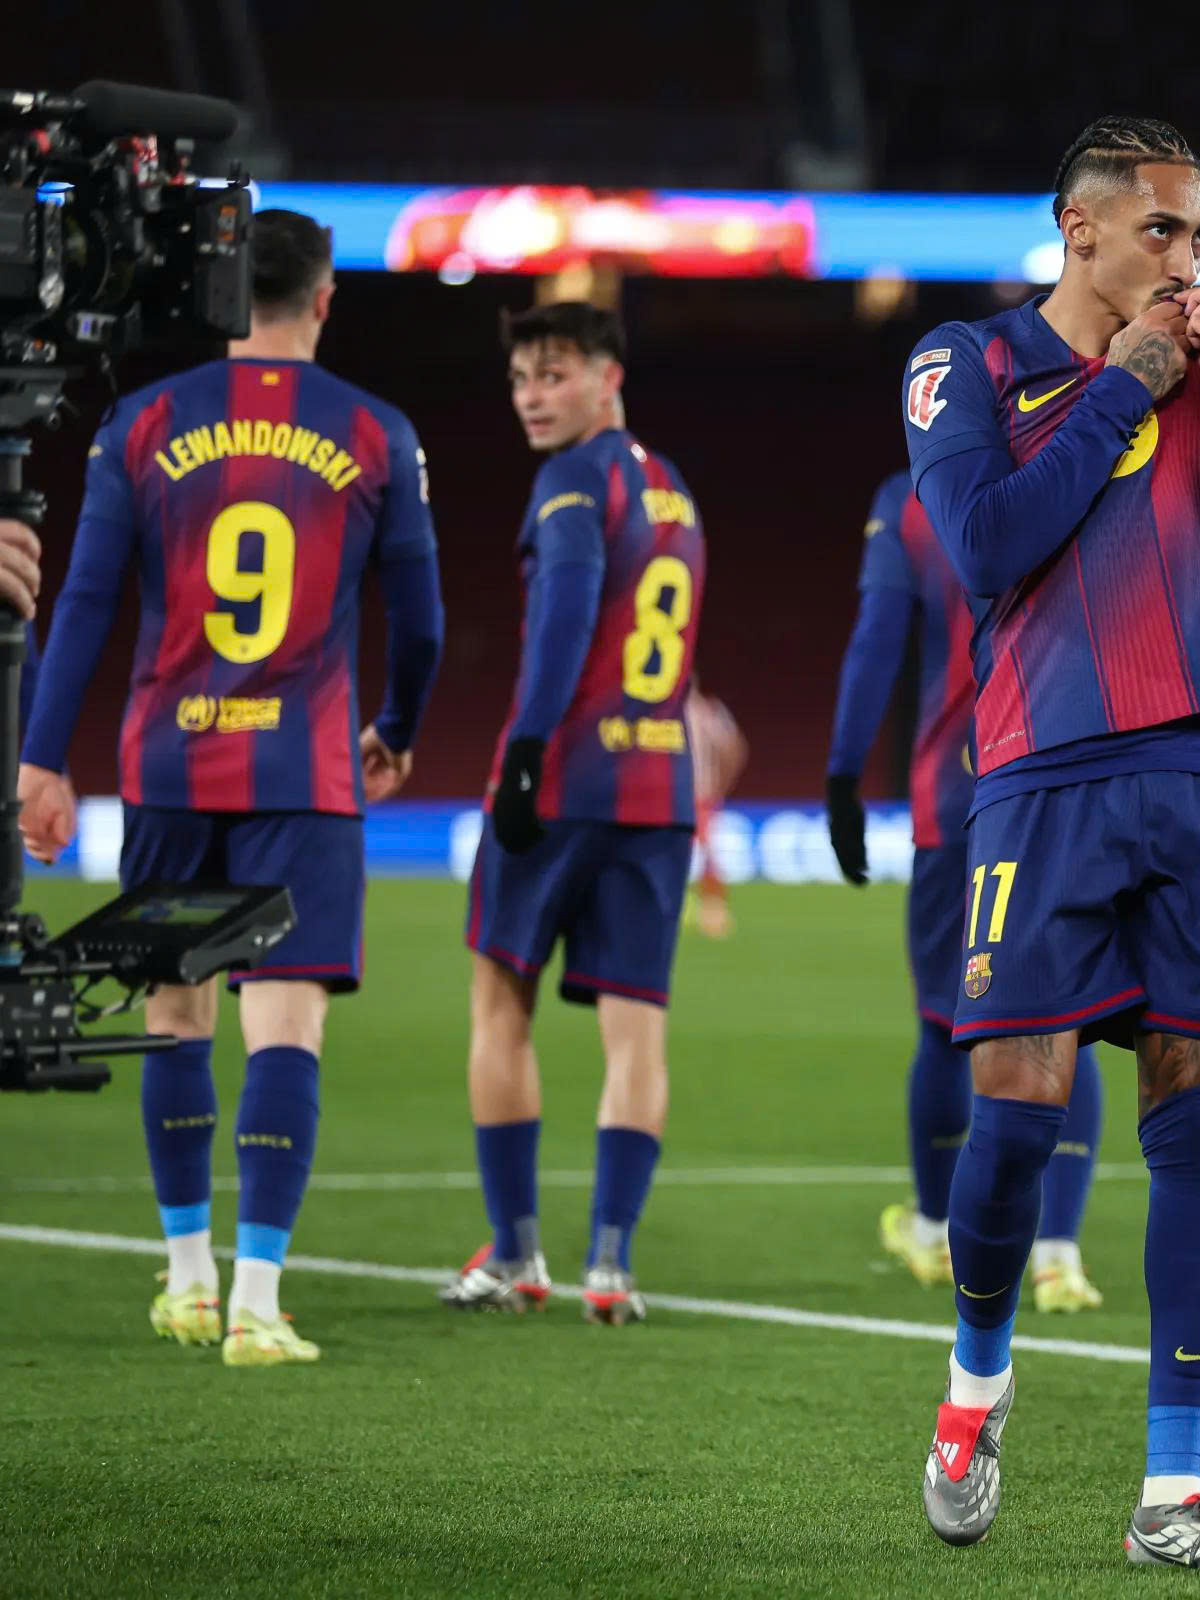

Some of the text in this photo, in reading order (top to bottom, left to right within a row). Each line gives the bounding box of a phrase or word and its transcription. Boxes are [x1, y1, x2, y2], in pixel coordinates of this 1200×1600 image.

[154, 419, 362, 492] LEWANDOWSKI
[203, 500, 296, 665] 9
[623, 556, 693, 704] 8
[967, 861, 1018, 949] 11
